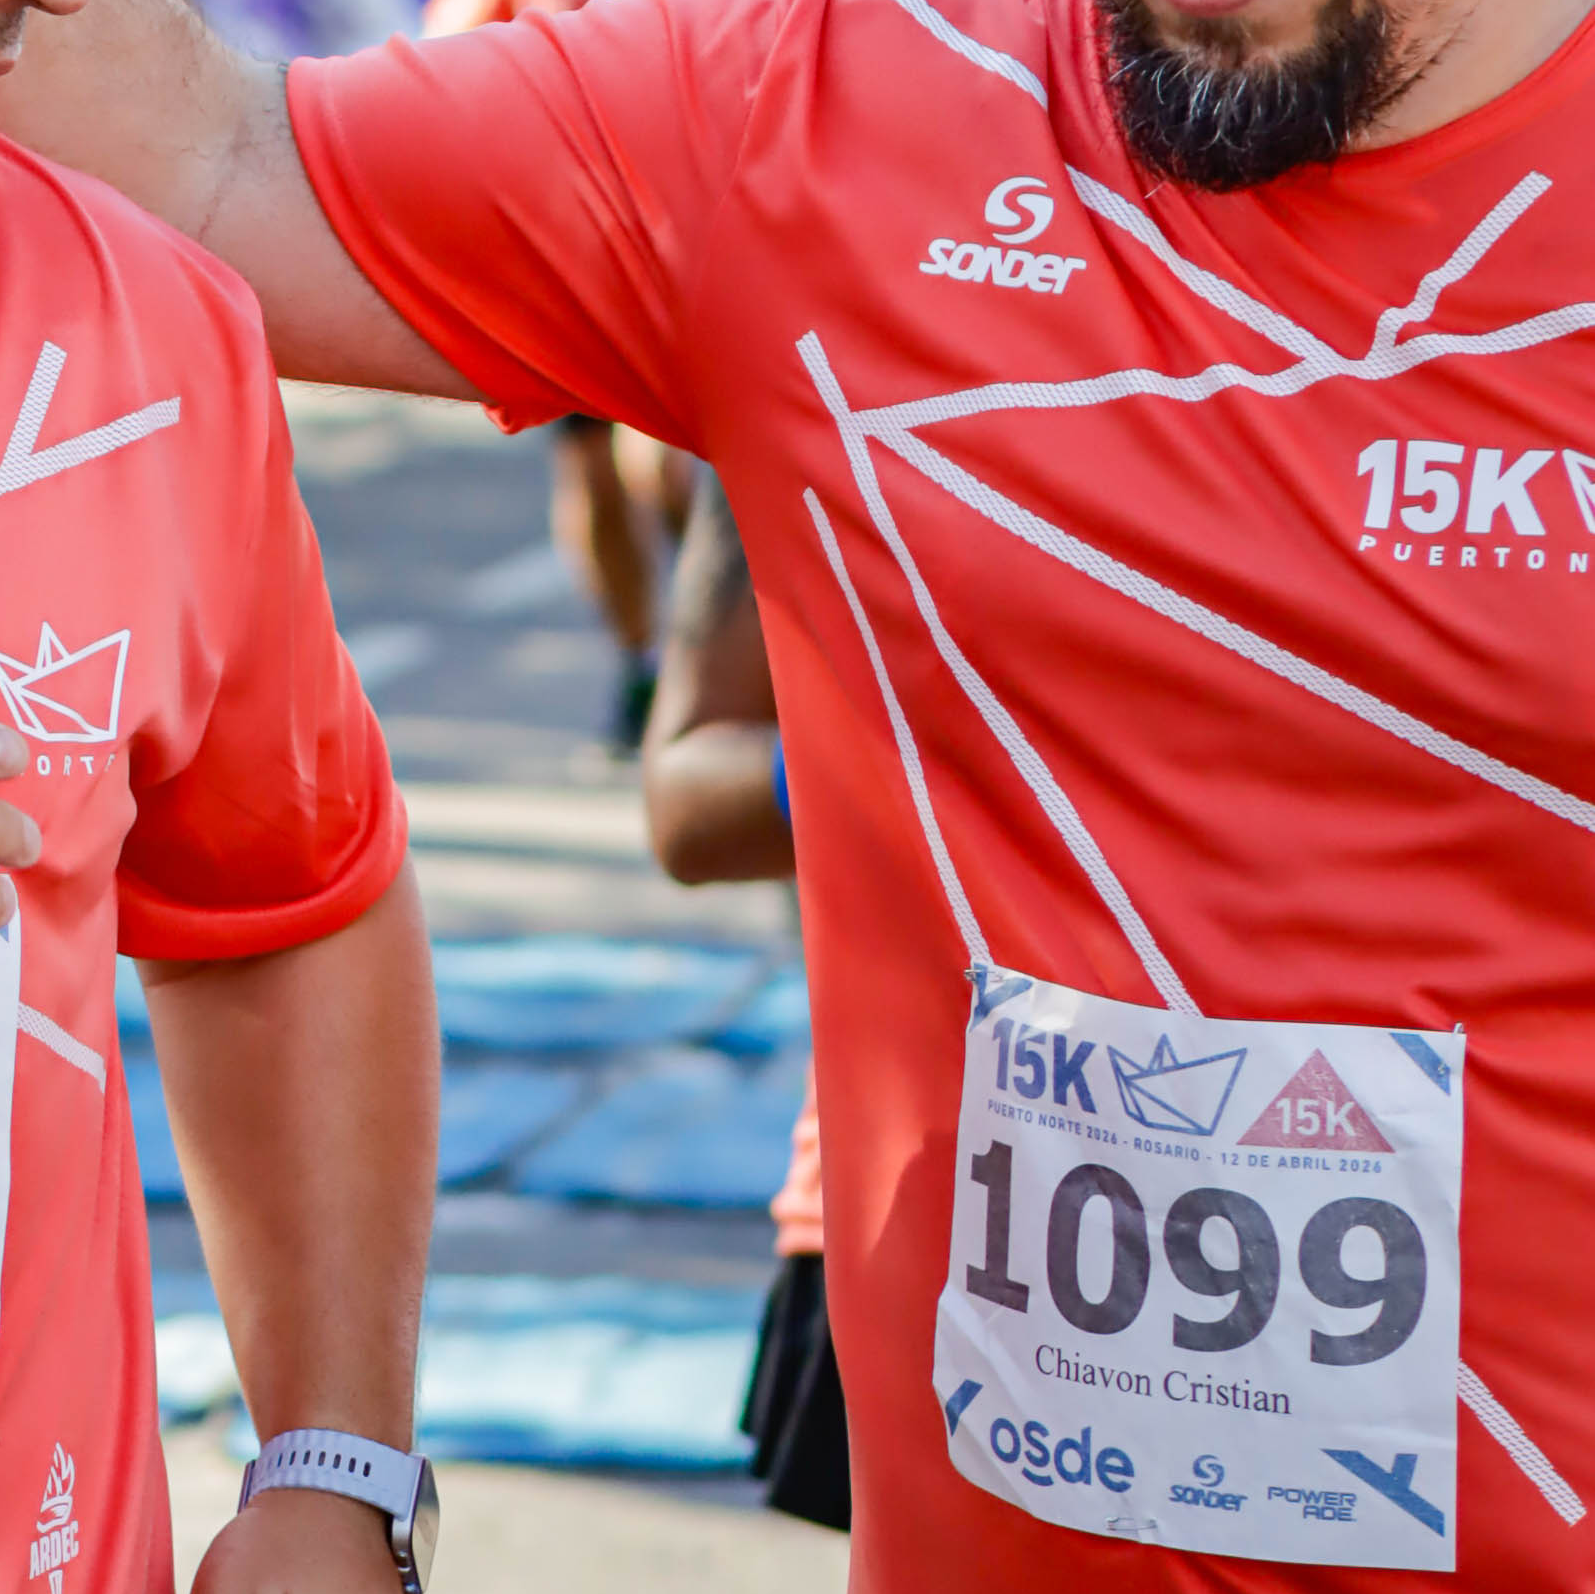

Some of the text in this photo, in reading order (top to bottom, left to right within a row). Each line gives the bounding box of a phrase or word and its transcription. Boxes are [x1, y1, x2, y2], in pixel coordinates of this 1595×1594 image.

[1357, 438, 1556, 536] 15K
[1358, 533, 1546, 570] PUERTO
[991, 1017, 1098, 1115] 15K
[988, 1098, 1033, 1123] PUERTO
[1038, 1113, 1082, 1136] NORTE
[1086, 1125, 1118, 1146] 2026
[1133, 1138, 1200, 1161] ROSARIO
[1220, 1151, 1240, 1166] 12
[1247, 1153, 1270, 1168] DE
[1277, 1156, 1331, 1171] ABRIL
[1339, 1158, 1383, 1174] 2026
[1275, 1097, 1360, 1139] 15K
[965, 1138, 1428, 1367] 1099
[1034, 1343, 1292, 1416] Chiavon Cristian
[990, 1417, 1135, 1493] osde
[1267, 1486, 1357, 1507] POWER
[29, 1519, 79, 1581] ARDEC
